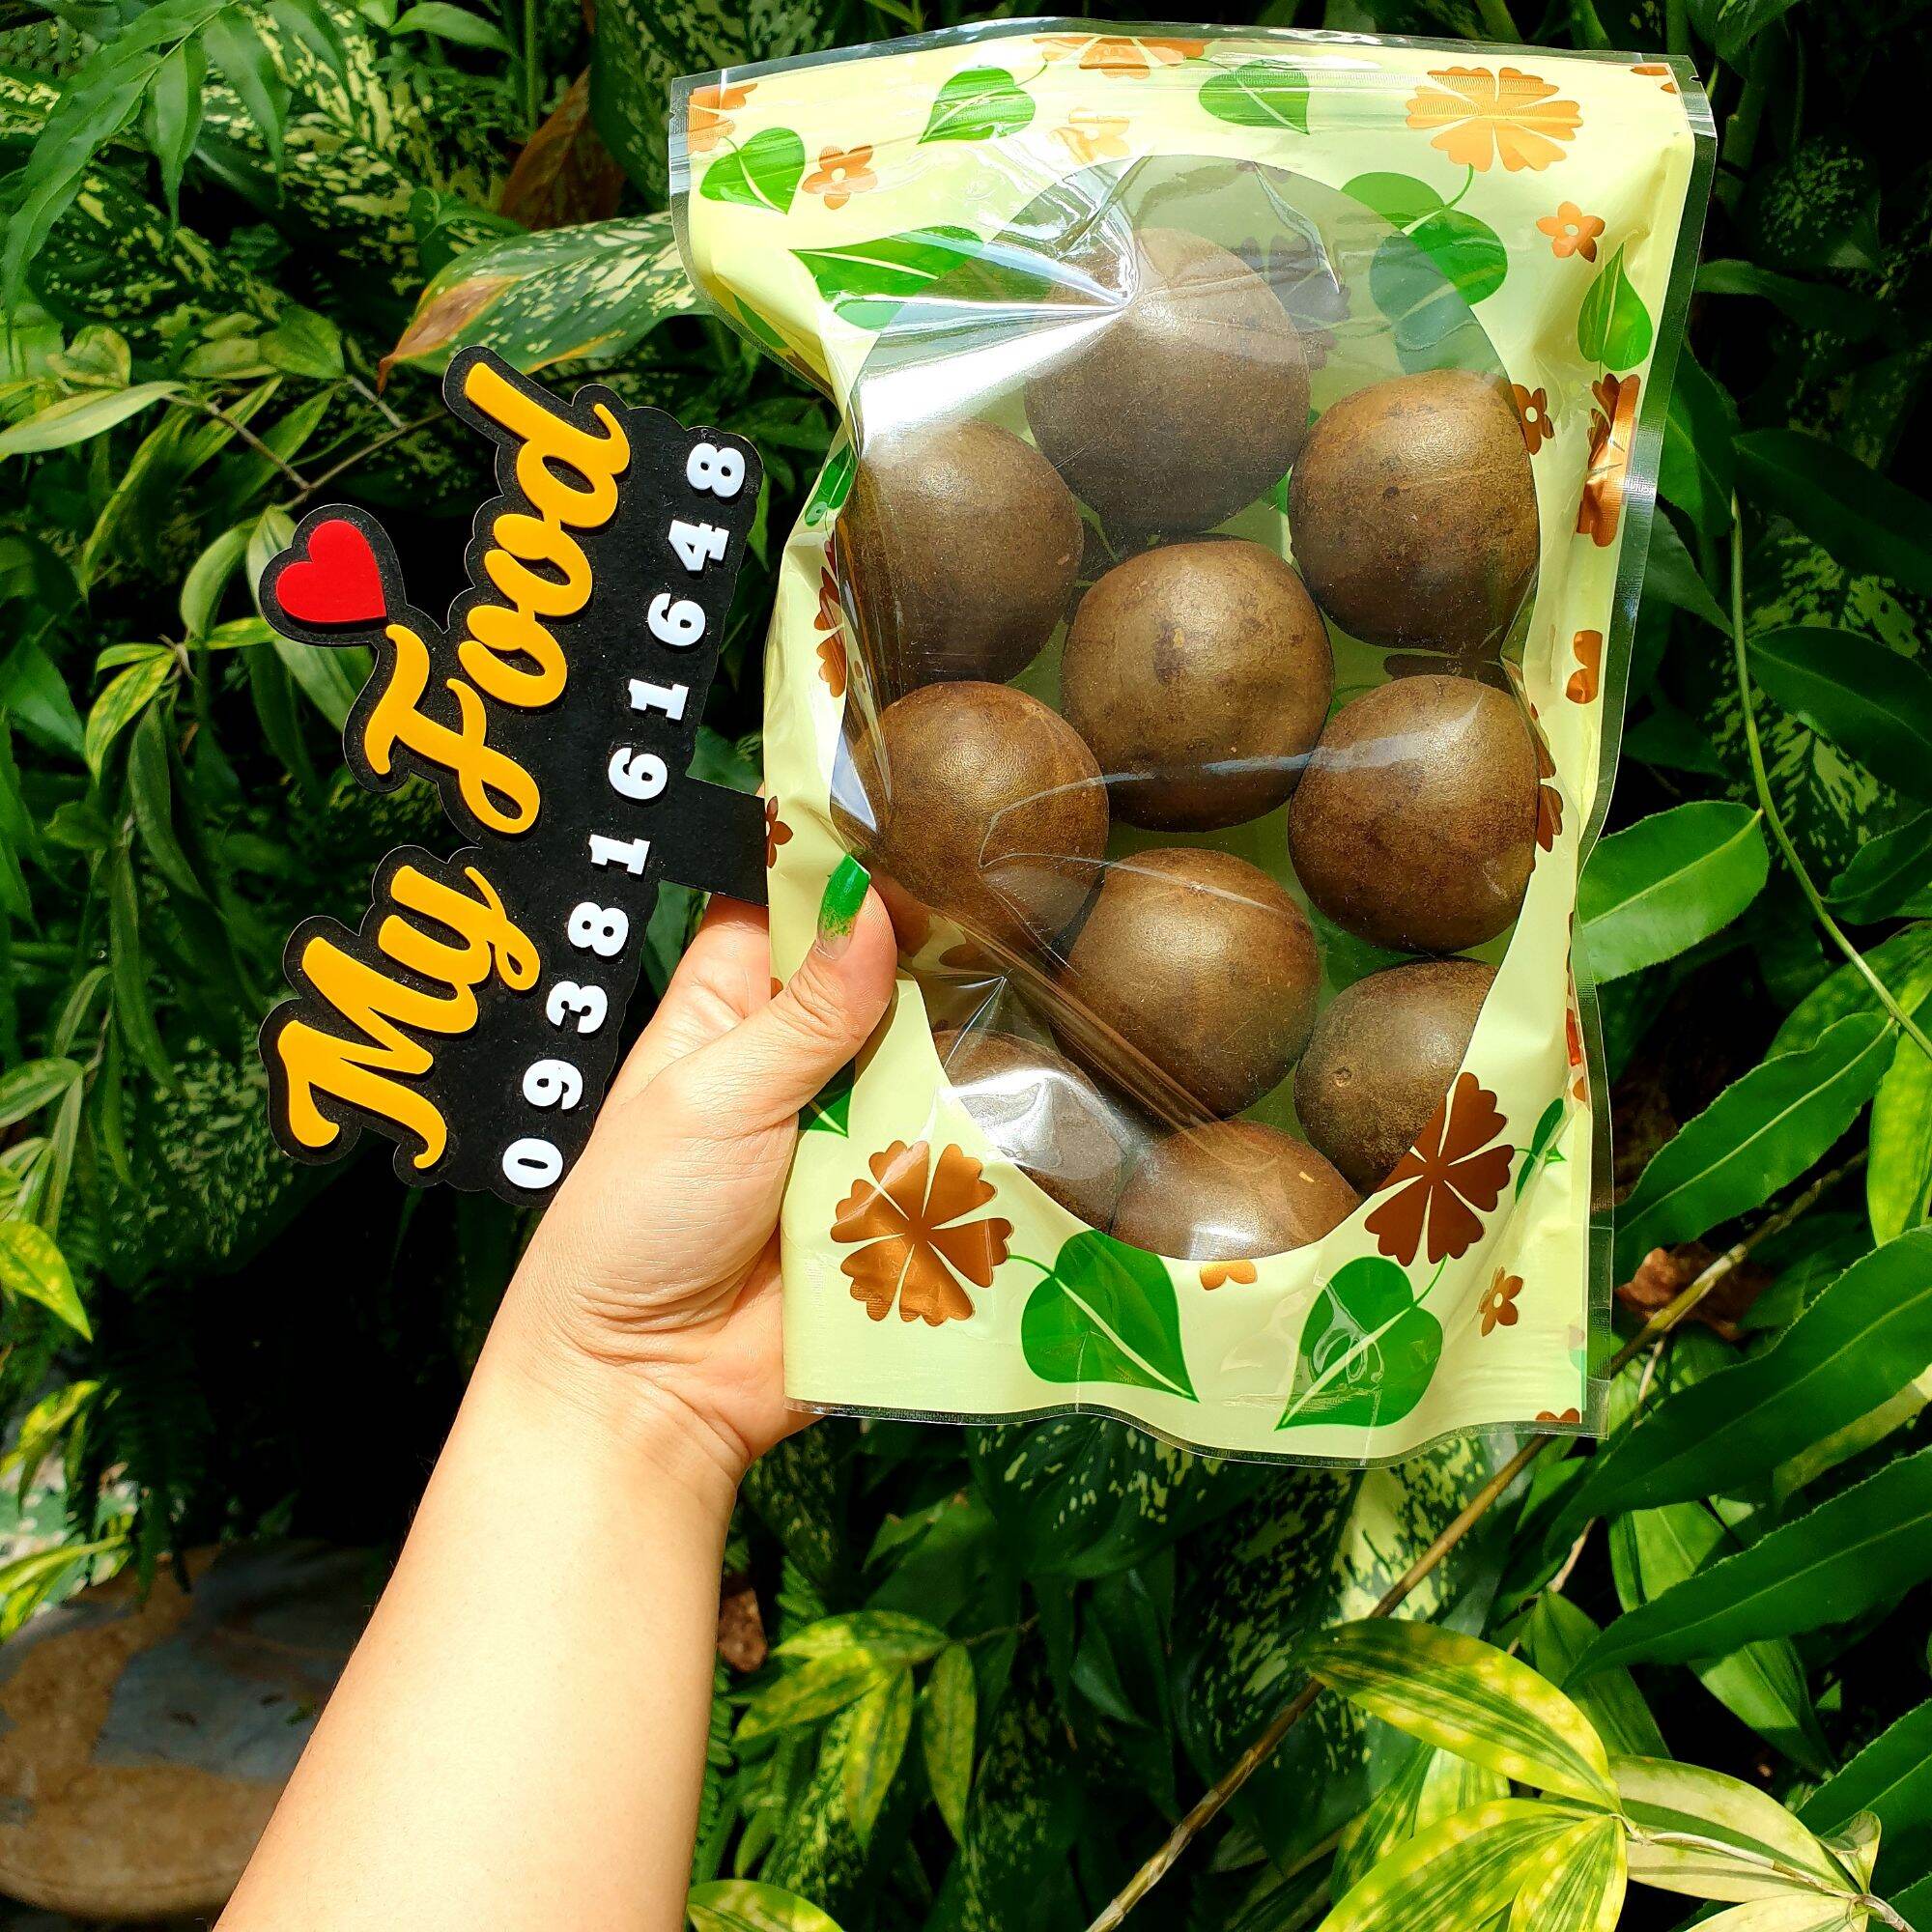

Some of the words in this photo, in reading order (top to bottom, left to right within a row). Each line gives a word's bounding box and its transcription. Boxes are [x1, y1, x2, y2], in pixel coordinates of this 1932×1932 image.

[365, 362, 630, 835] Food
[501, 441, 746, 1190] 0938161648
[277, 866, 539, 1169] My
